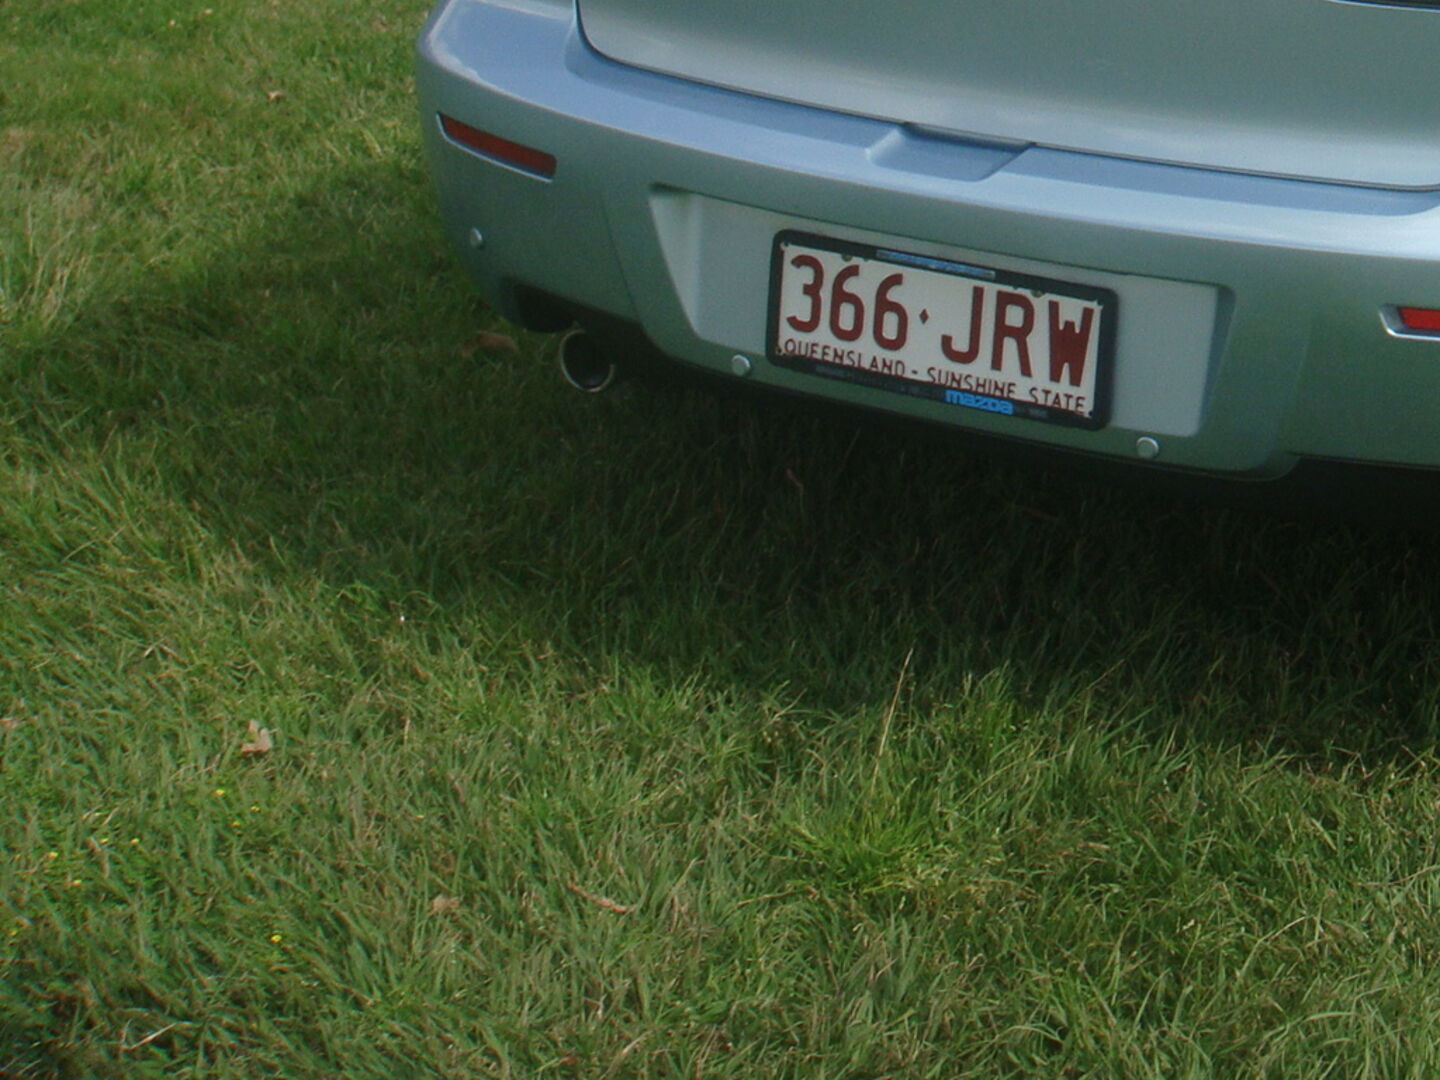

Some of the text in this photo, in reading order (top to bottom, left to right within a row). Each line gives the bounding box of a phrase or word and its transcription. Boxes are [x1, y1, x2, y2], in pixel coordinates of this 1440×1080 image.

[785, 253, 1095, 388] 366 JRW
[784, 337, 905, 377] QUEENSLAND
[926, 366, 1017, 400] SUNSHINE
[1028, 386, 1087, 416] STATE
